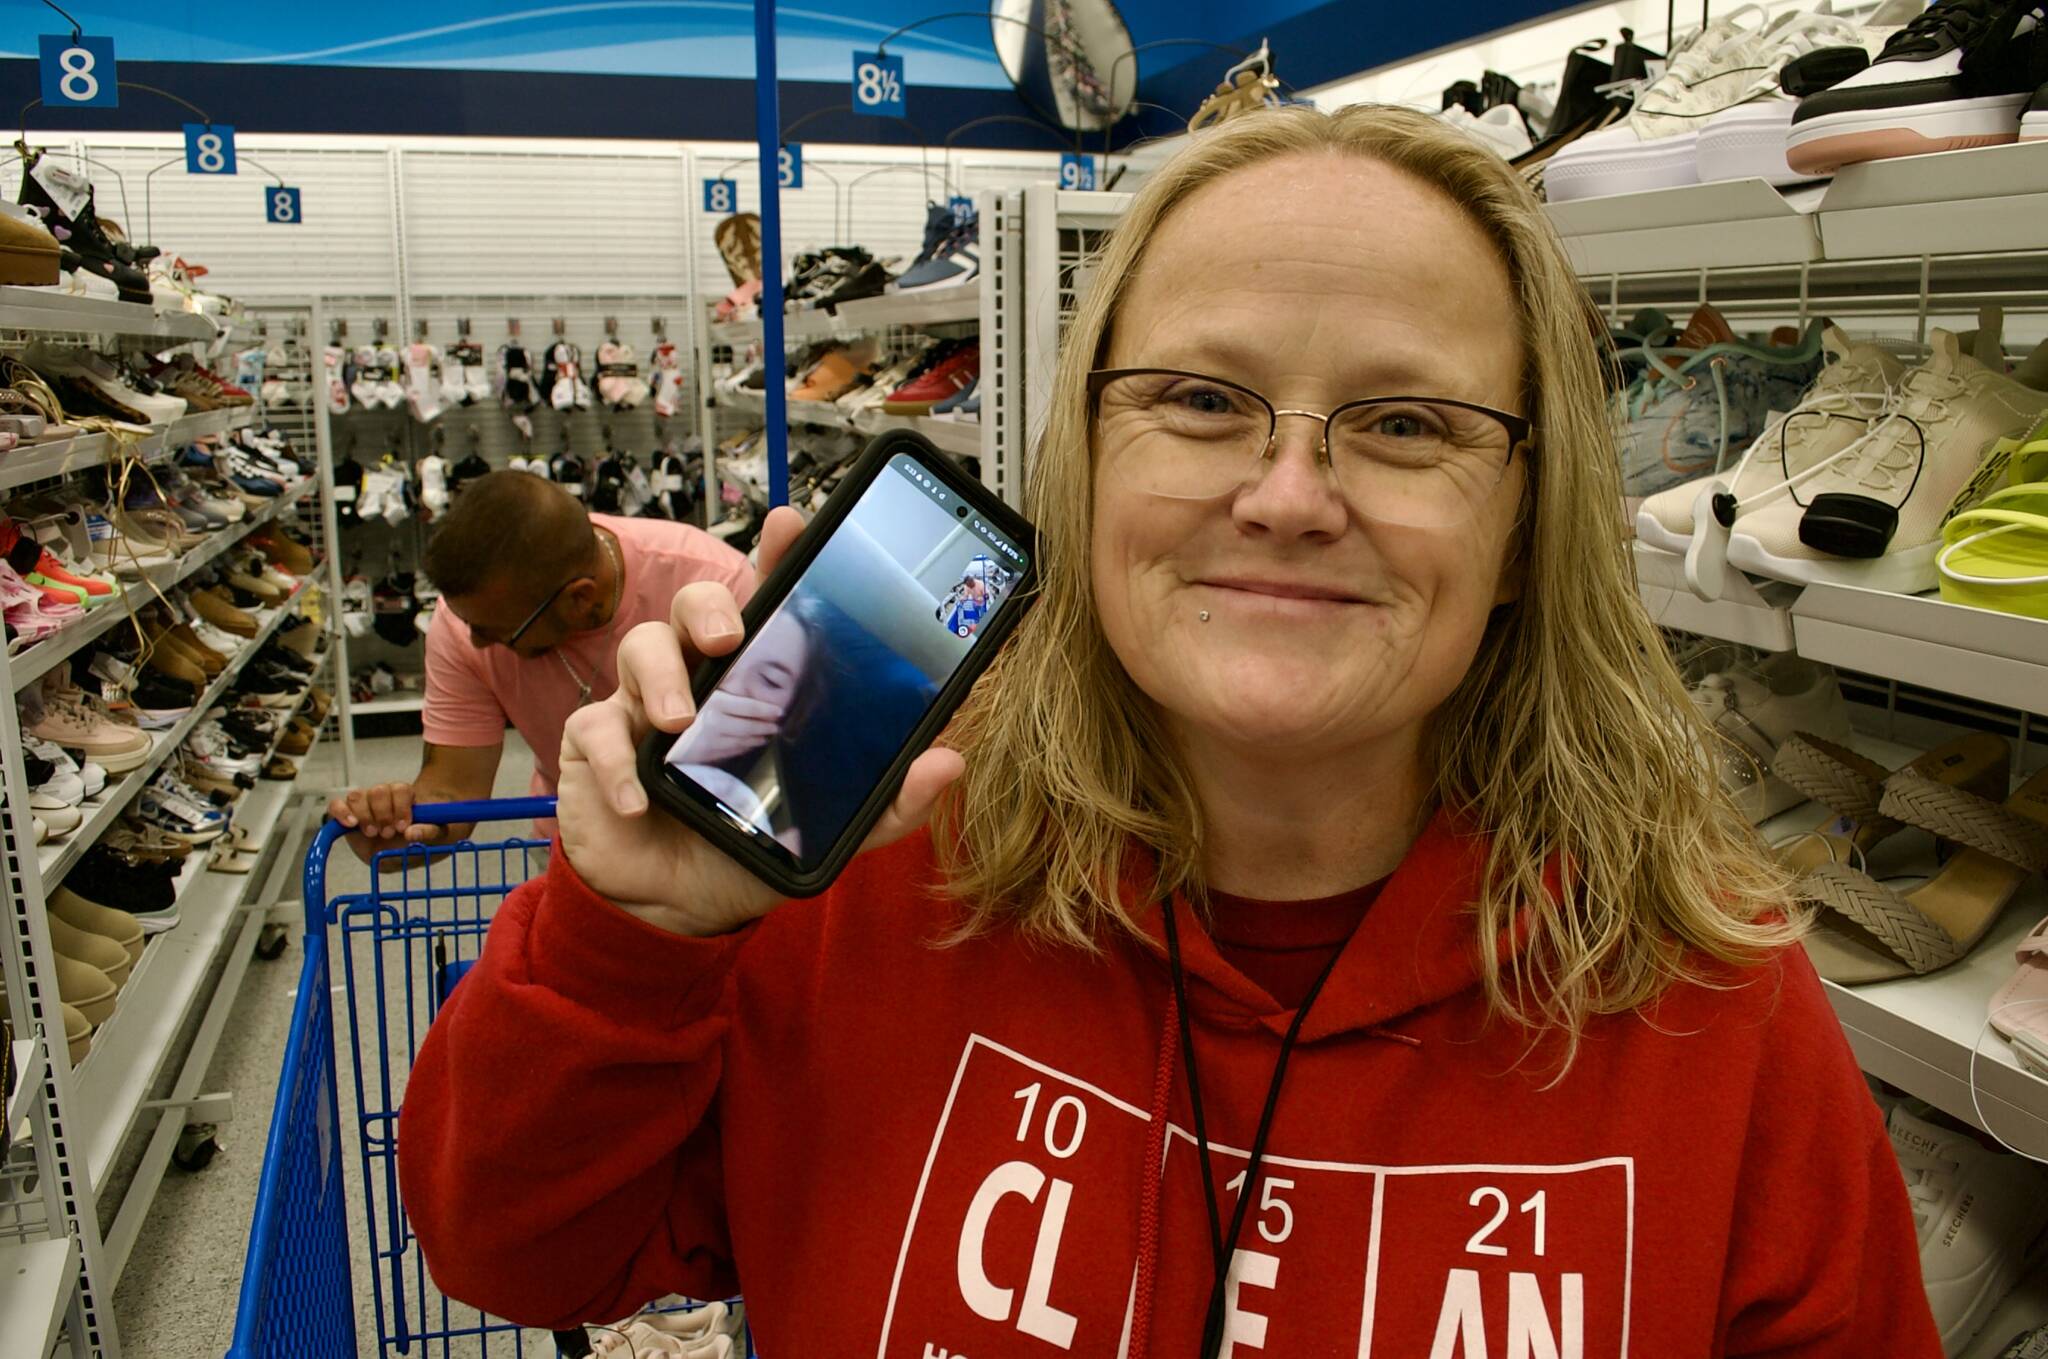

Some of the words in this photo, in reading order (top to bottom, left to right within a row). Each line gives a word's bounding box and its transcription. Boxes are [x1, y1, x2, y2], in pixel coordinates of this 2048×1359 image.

[60, 48, 98, 101] 8
[197, 134, 225, 172] 8
[274, 192, 294, 221] 8
[711, 182, 729, 211] 8
[1014, 1082, 1087, 1158] 10
[1465, 1186, 1546, 1256] 21
[1941, 1194, 1975, 1248] SKECHERS
[957, 1160, 1079, 1350] CL
[1429, 1268, 1583, 1359] AN
